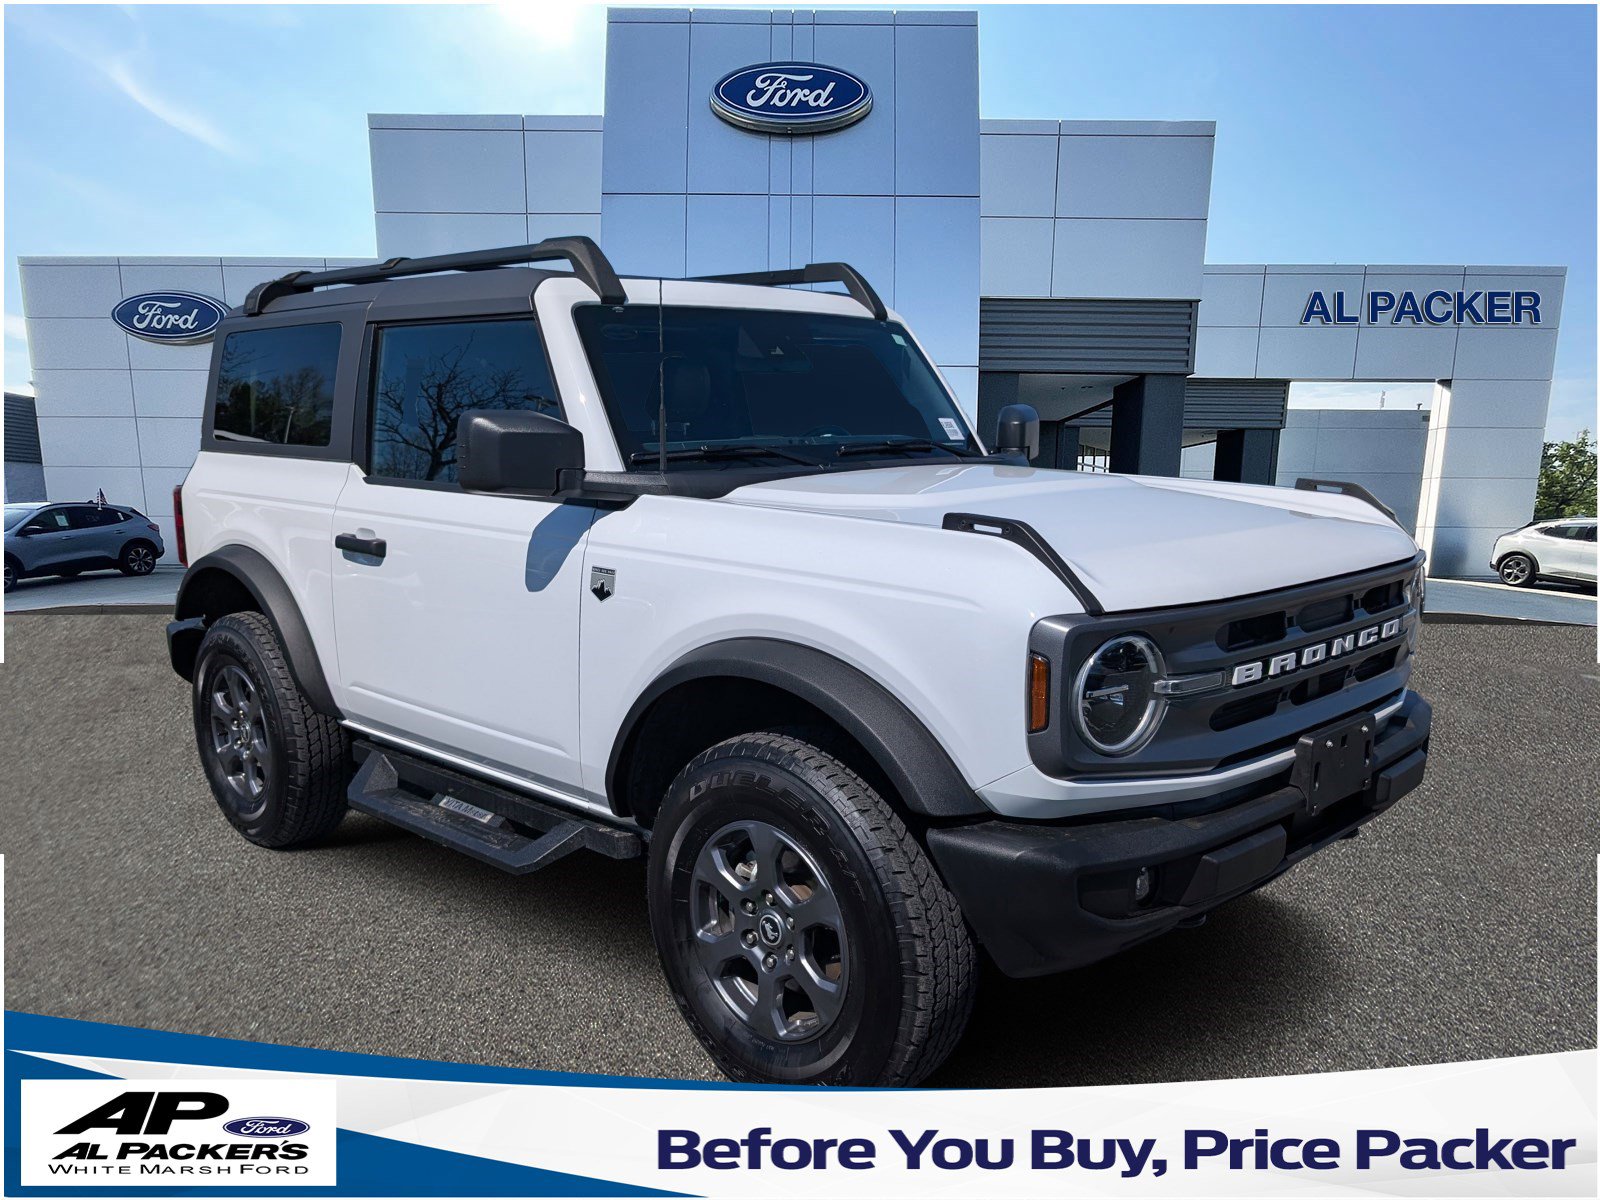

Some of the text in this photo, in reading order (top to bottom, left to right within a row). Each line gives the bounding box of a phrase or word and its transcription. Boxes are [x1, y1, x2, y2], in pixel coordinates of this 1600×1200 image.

[746, 73, 836, 107] Ford
[133, 301, 199, 329] Ford
[1301, 290, 1542, 324] AL PACKER
[1231, 618, 1400, 686] BRONCO
